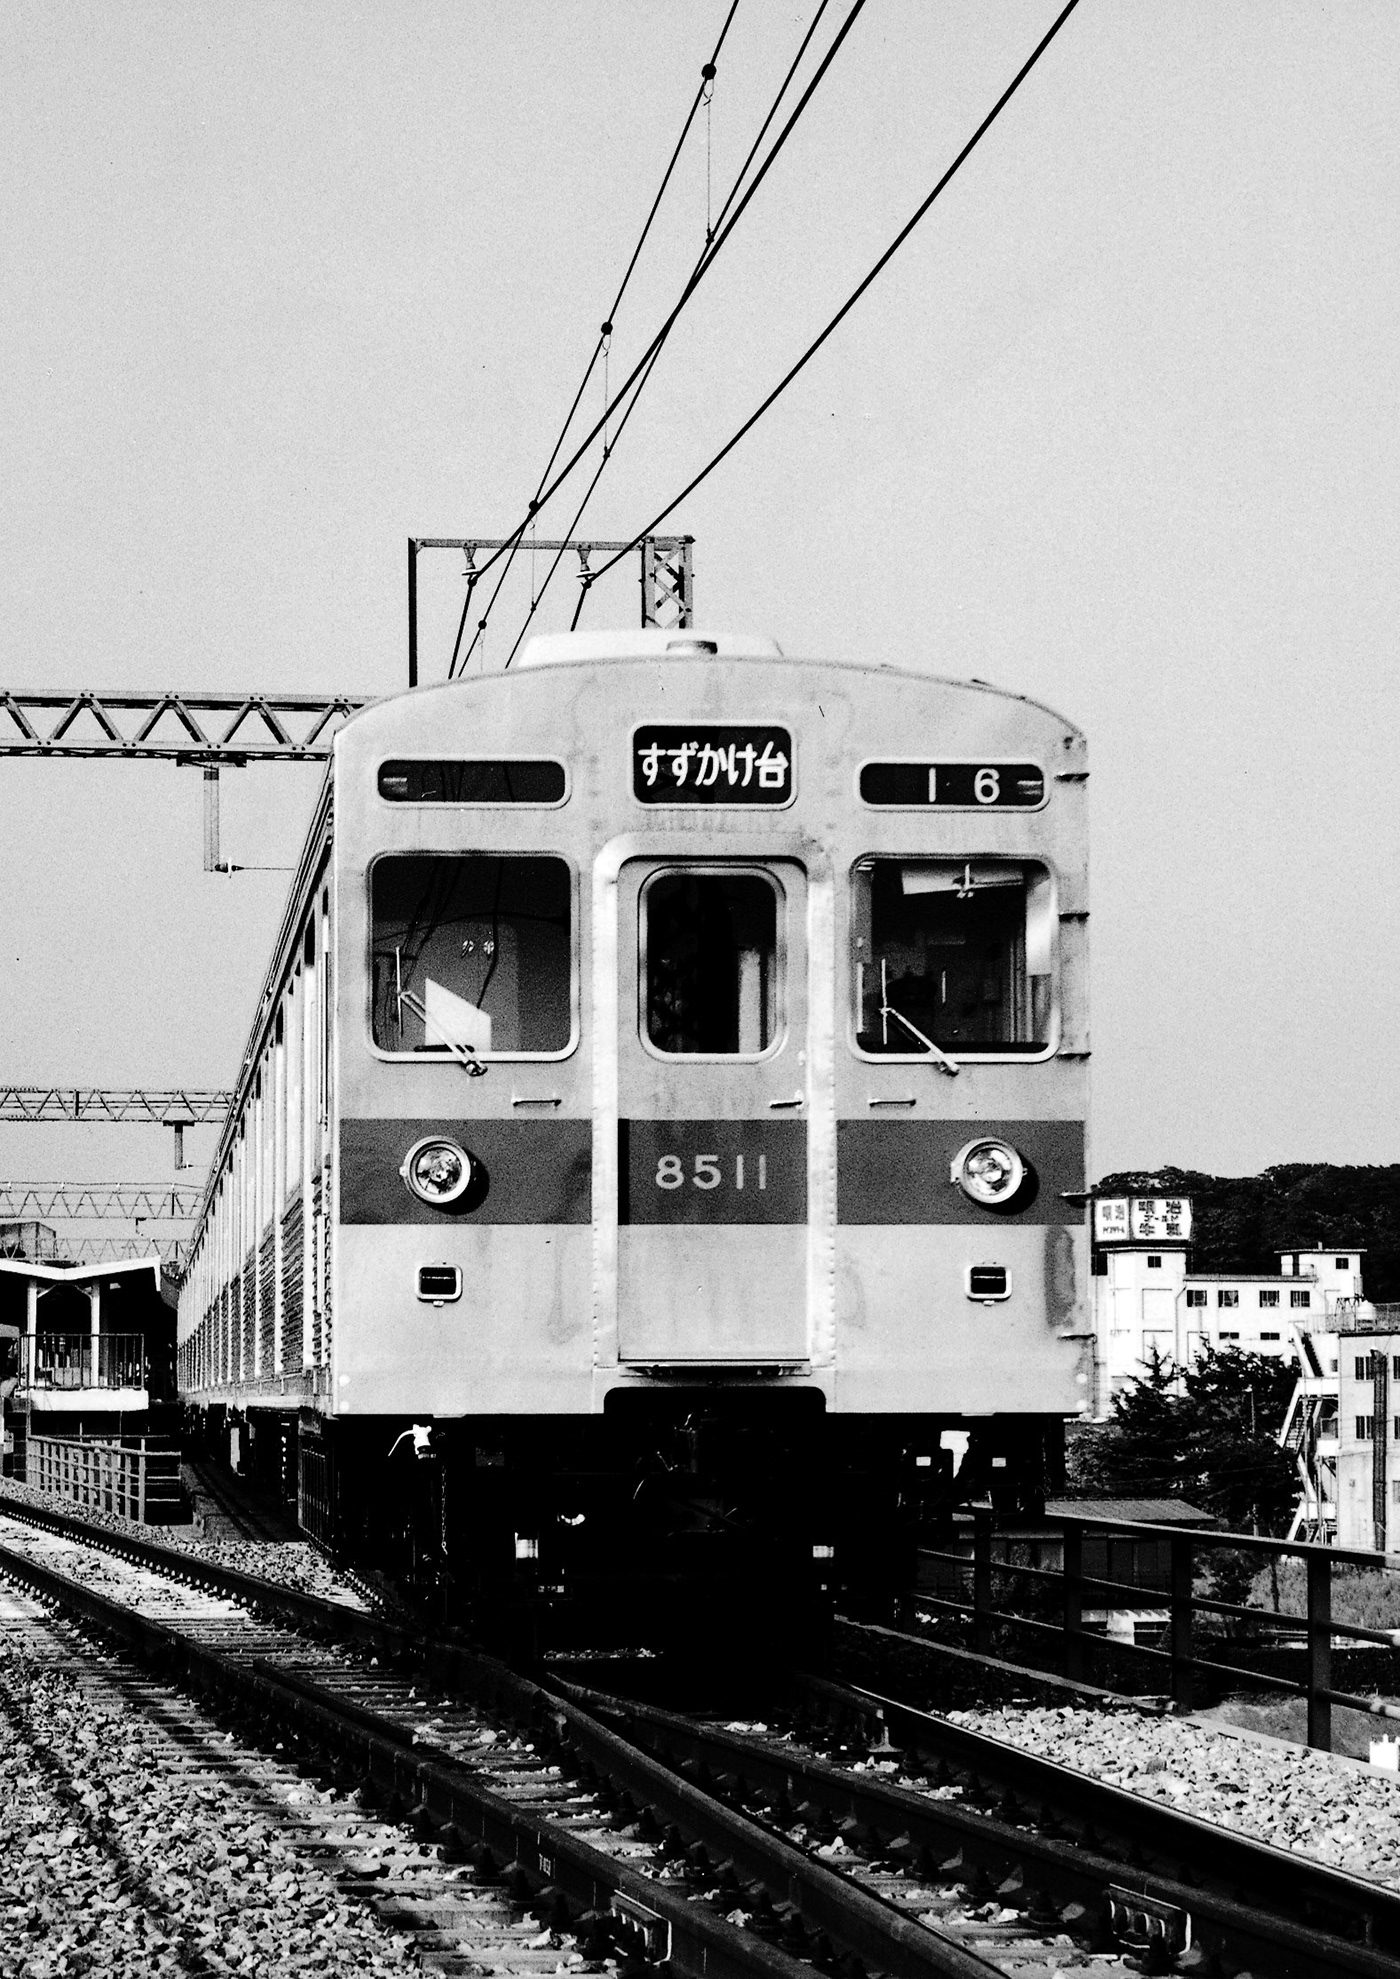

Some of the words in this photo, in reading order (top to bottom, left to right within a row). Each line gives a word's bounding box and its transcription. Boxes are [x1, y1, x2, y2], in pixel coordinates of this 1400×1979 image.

[637, 741, 789, 788] すずかけ台
[655, 1154, 767, 1190] 8511
